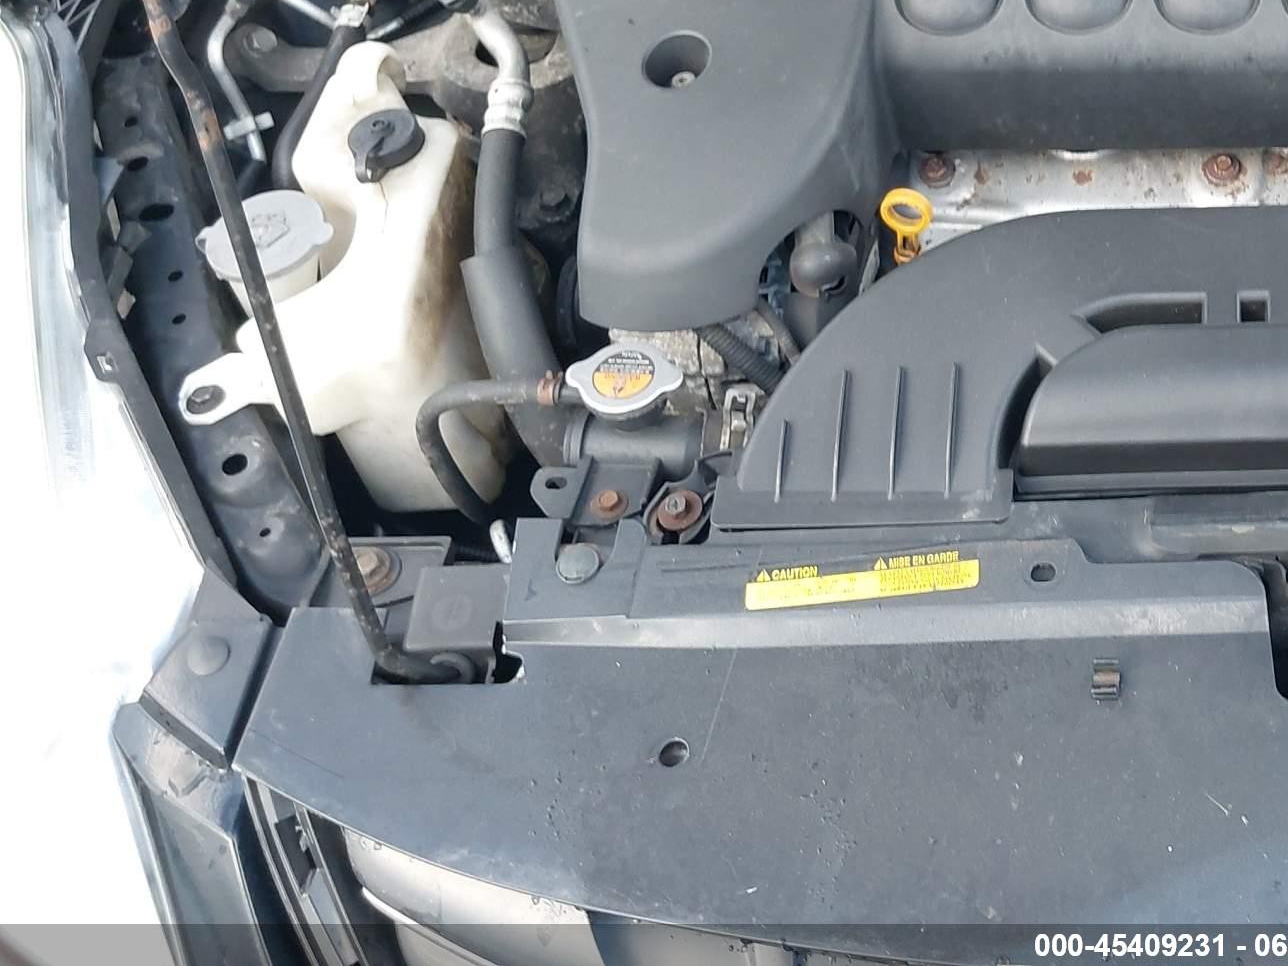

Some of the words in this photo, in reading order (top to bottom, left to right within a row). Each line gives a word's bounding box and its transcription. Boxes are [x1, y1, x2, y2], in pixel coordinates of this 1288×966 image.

[912, 554, 925, 566] EN
[926, 551, 960, 565] GARDE
[771, 565, 818, 581] CAUTION
